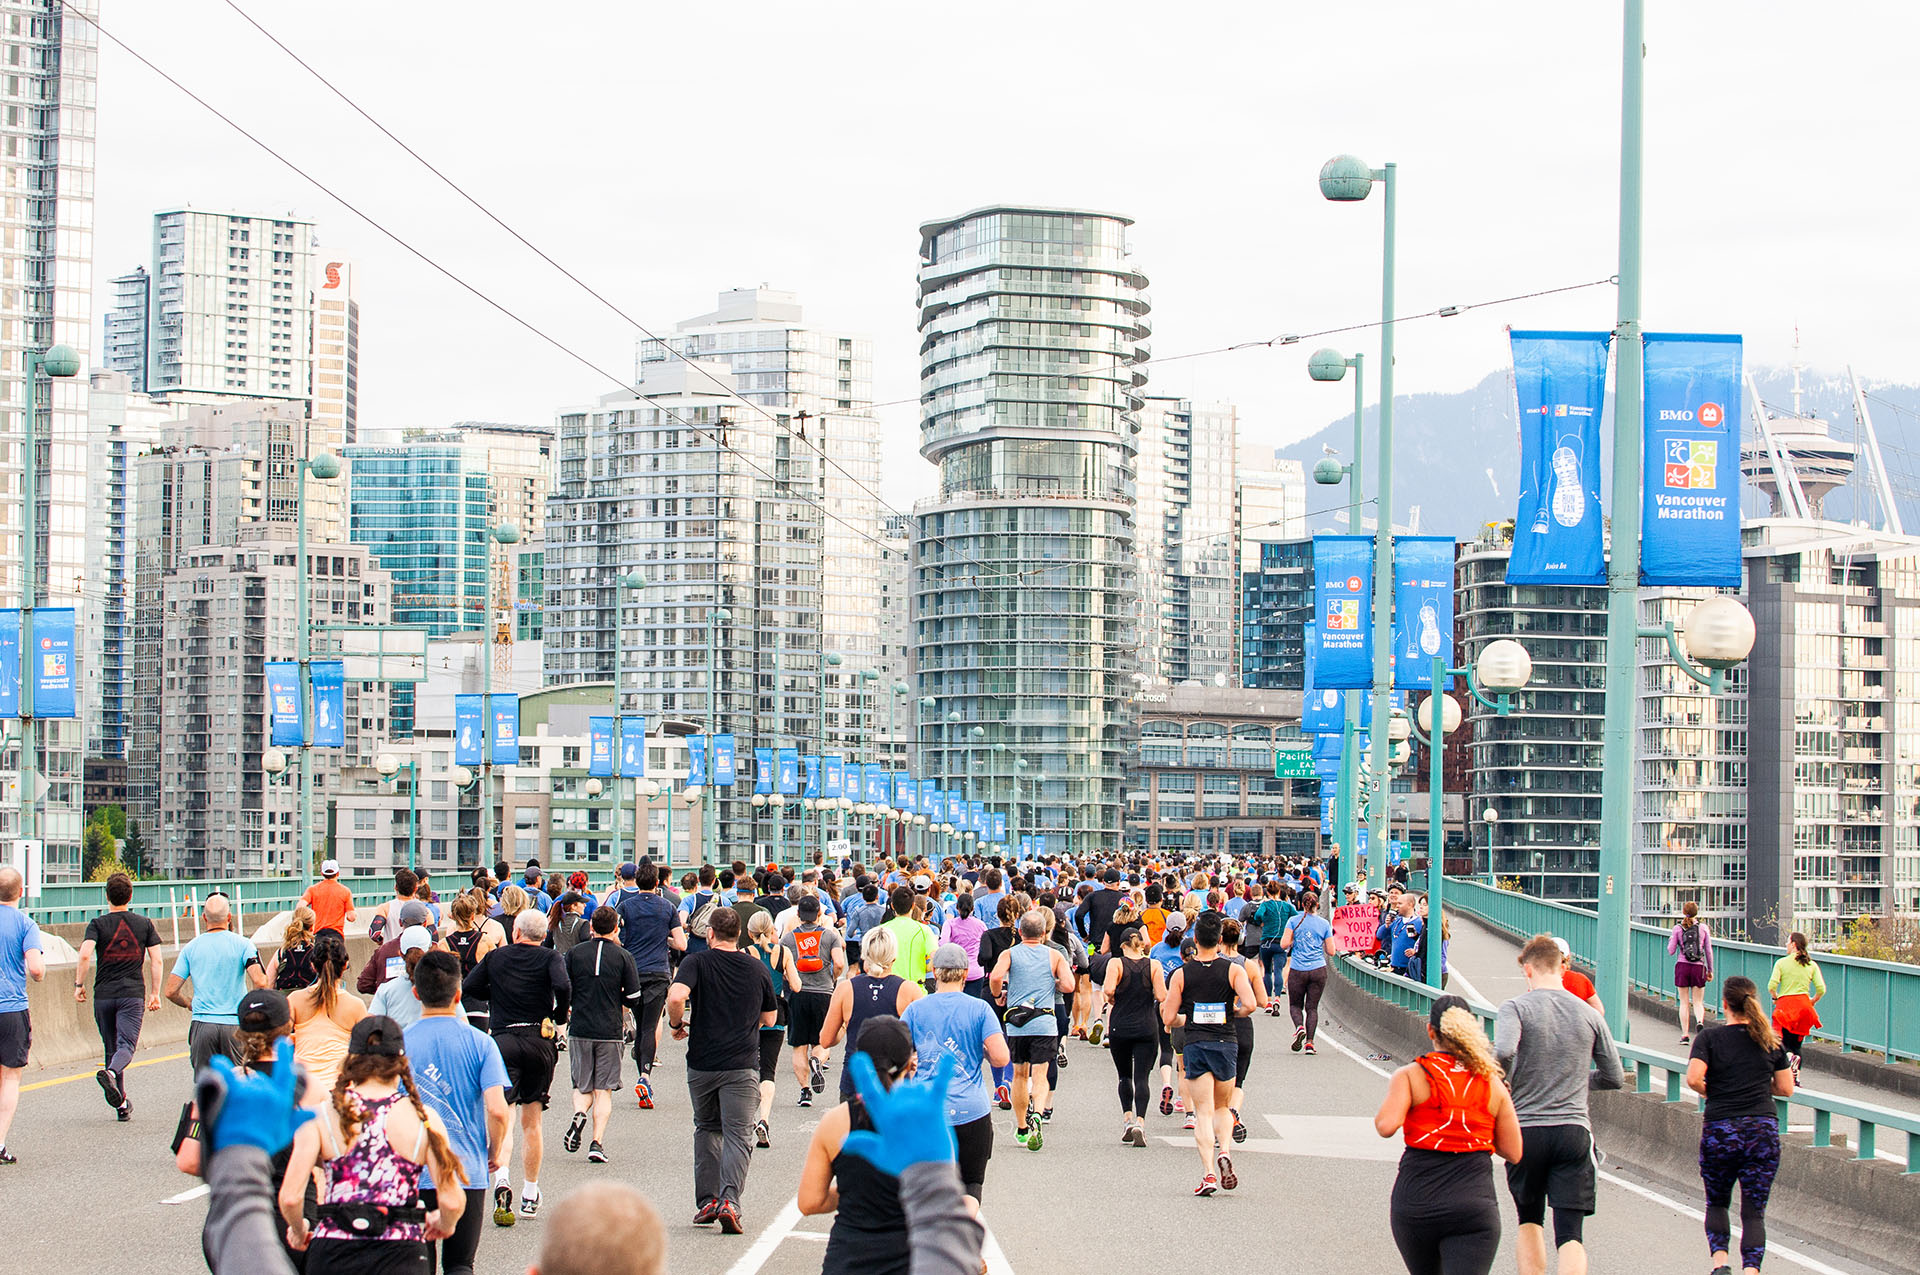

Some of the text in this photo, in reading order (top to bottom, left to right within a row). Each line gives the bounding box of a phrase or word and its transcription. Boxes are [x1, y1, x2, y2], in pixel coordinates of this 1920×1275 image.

[1659, 409, 1694, 422] BMO
[374, 447, 408, 455] WESTIN
[1656, 494, 1727, 507] Vancouver
[1657, 507, 1724, 520] Marathon
[1545, 562, 1567, 571] Join In
[1325, 581, 1345, 589] BMO
[1322, 632, 1365, 641] Vancouver
[1323, 640, 1363, 649] Marathon
[1134, 691, 1167, 703] Microsoft
[1334, 906, 1378, 920] EMBRACE
[1346, 921, 1373, 935] YOUR
